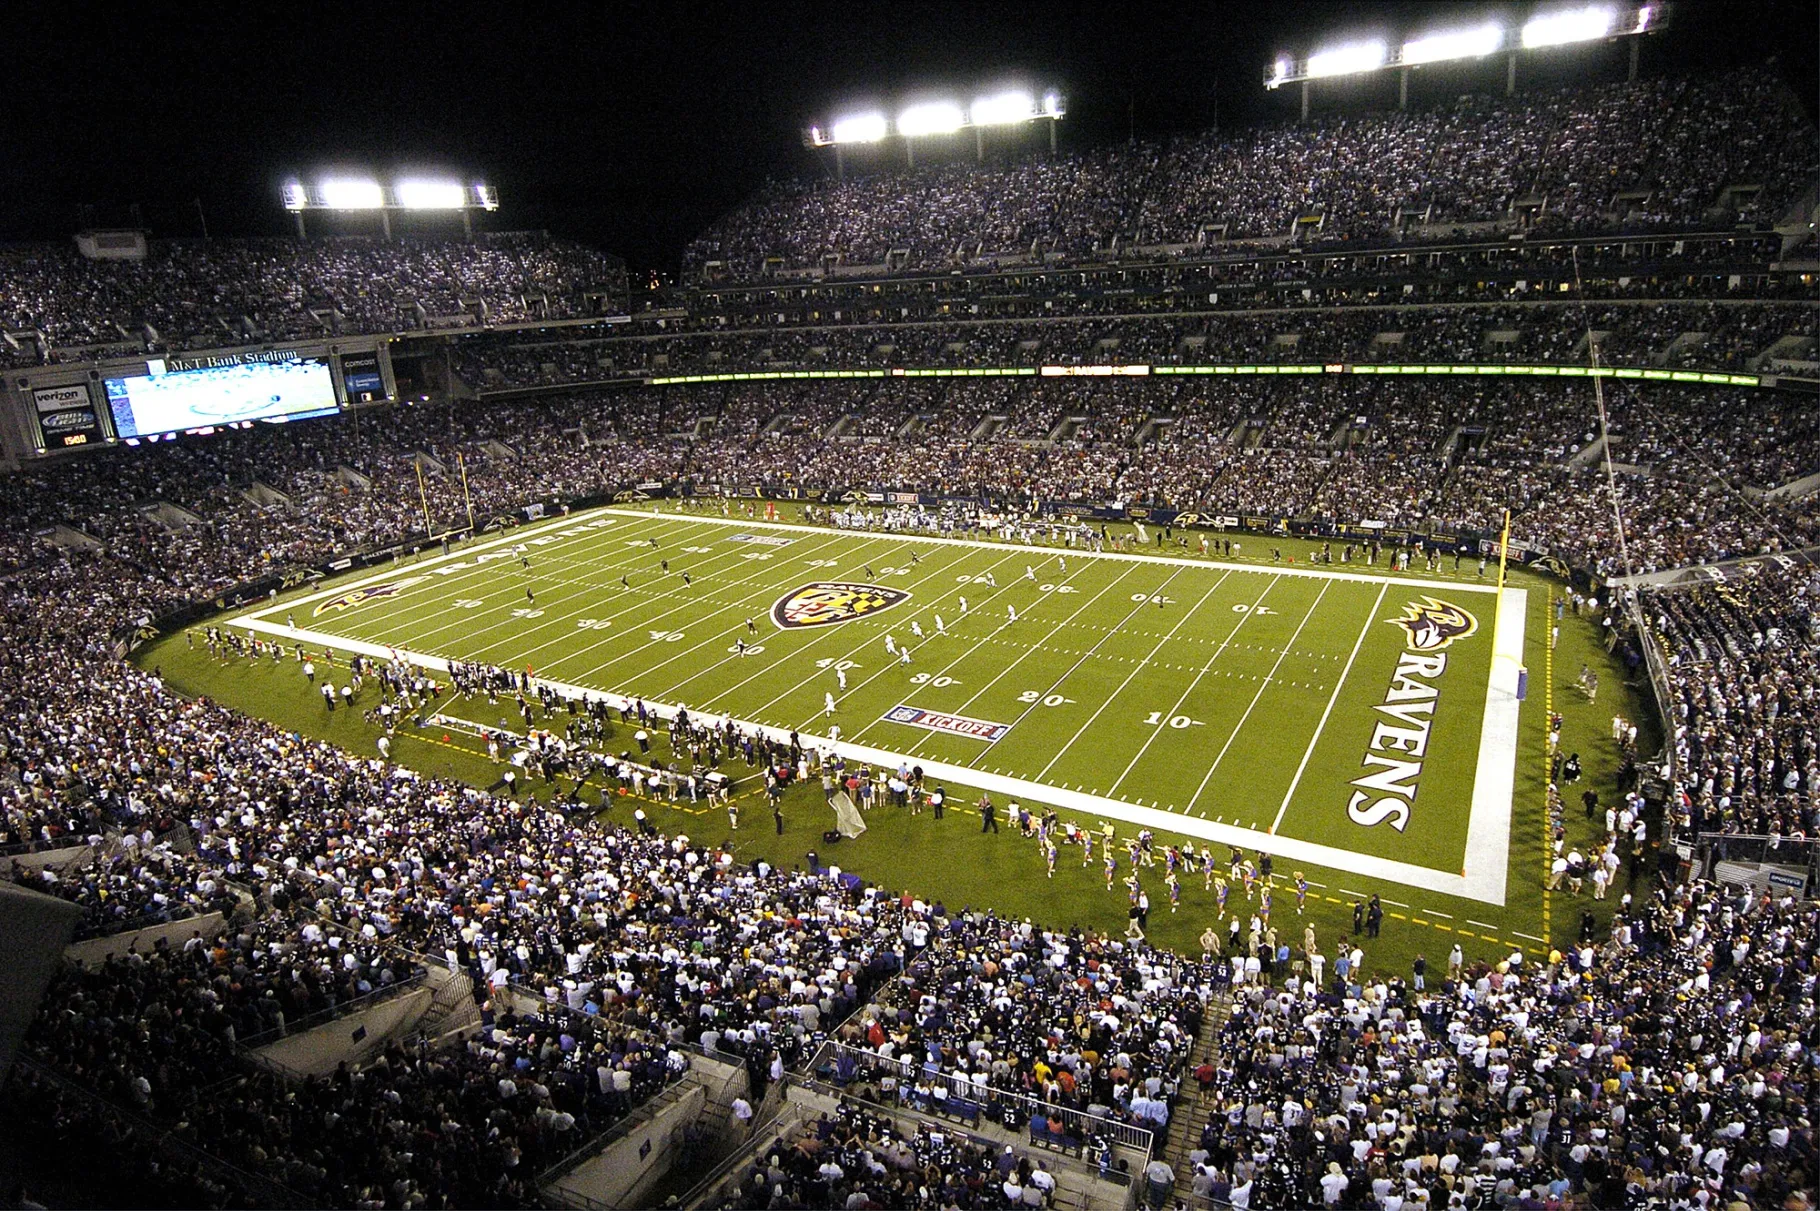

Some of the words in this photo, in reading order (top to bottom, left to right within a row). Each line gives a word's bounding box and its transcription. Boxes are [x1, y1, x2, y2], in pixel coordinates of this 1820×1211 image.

[171, 358, 201, 371] M&T
[207, 354, 242, 367] Bank
[245, 350, 298, 363] Stadium
[36, 391, 78, 402] verizon
[815, 583, 898, 599] RAVENS
[815, 657, 854, 671] 40
[909, 672, 953, 688] 30
[1016, 690, 1065, 707] 20
[917, 712, 995, 737] KICKOFF
[1142, 711, 1192, 729] 10
[1346, 651, 1448, 833] RAVENS
[1004, 1112, 1016, 1124] 52
[1560, 1134, 1571, 1144] 31
[940, 1155, 952, 1165] 52
[982, 1158, 992, 1169] 52
